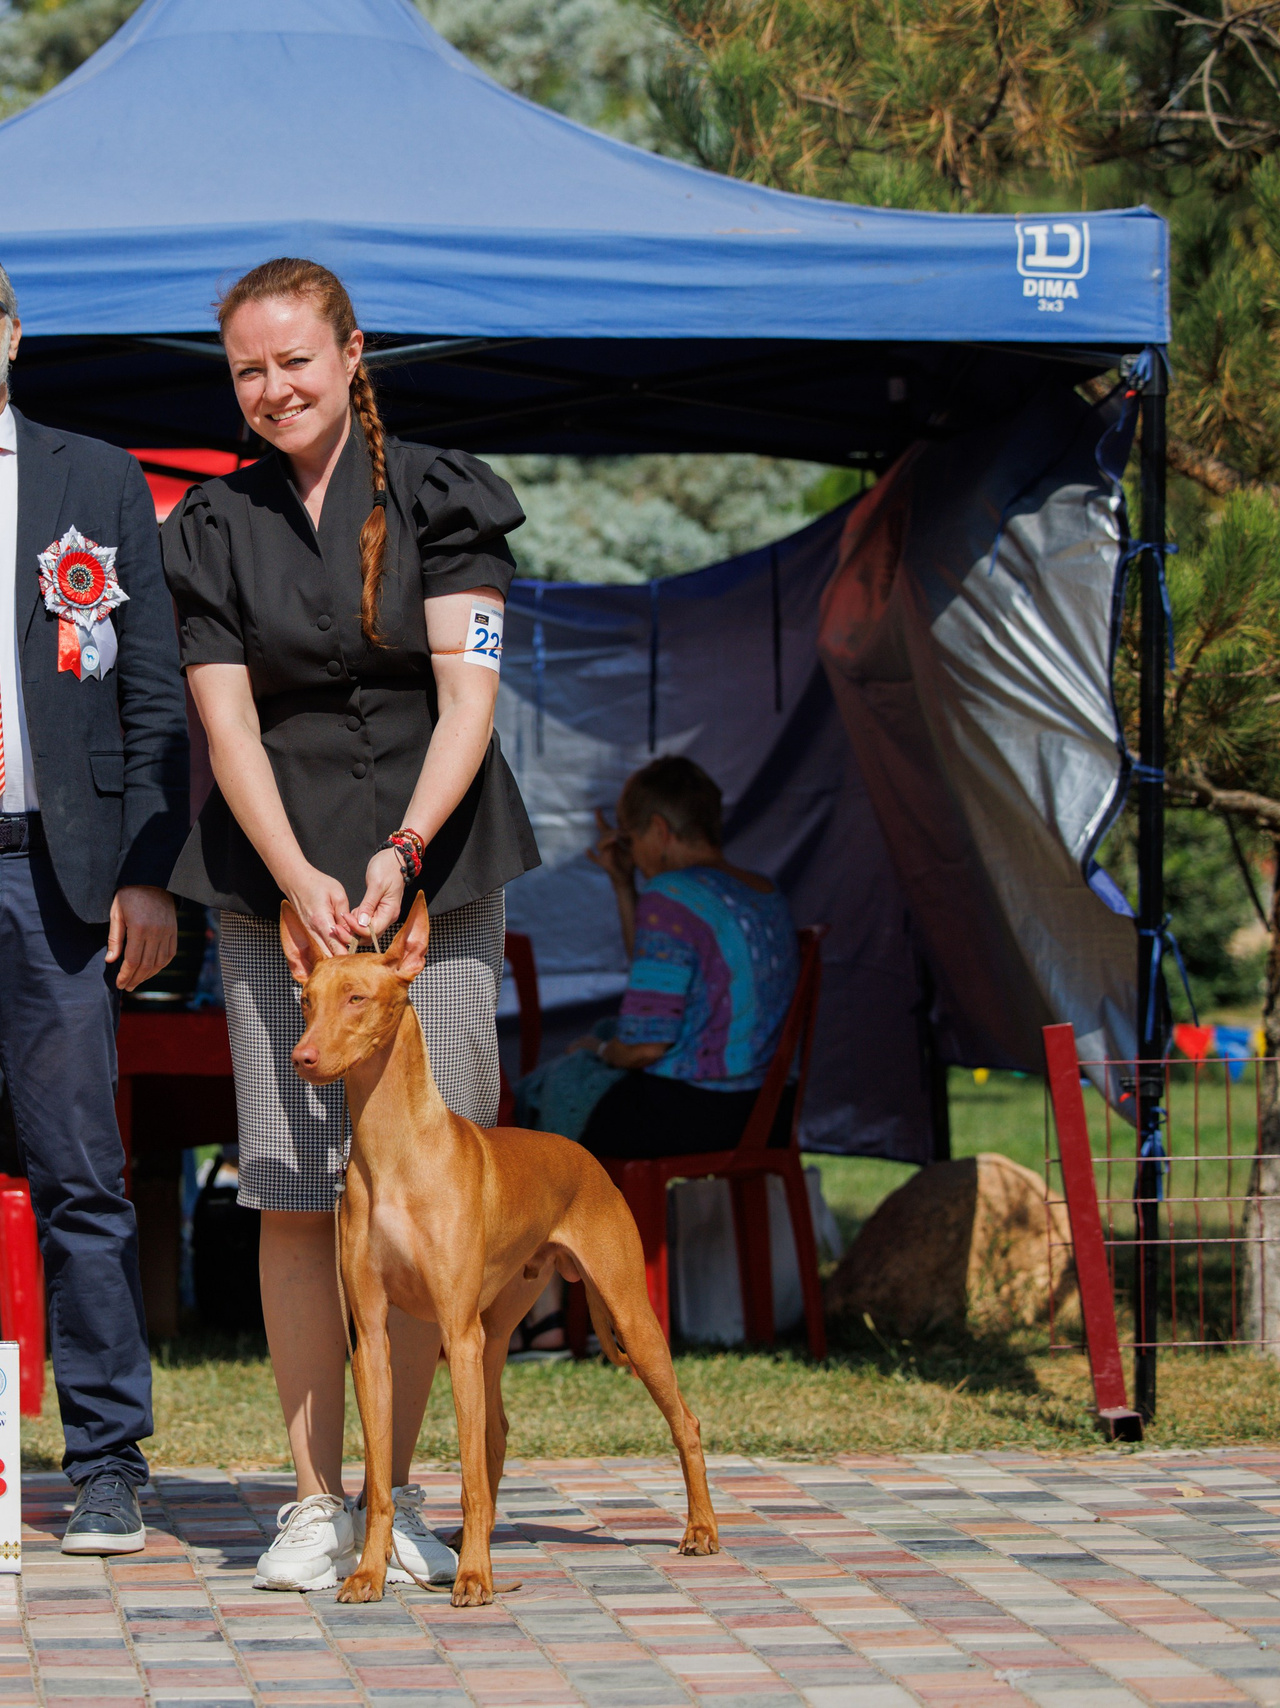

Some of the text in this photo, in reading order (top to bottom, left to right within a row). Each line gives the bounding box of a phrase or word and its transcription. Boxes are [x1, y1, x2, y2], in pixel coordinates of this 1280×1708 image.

[1023, 279, 1079, 299] DIMA
[1038, 299, 1065, 312] 3x3
[472, 628, 503, 659] 22
